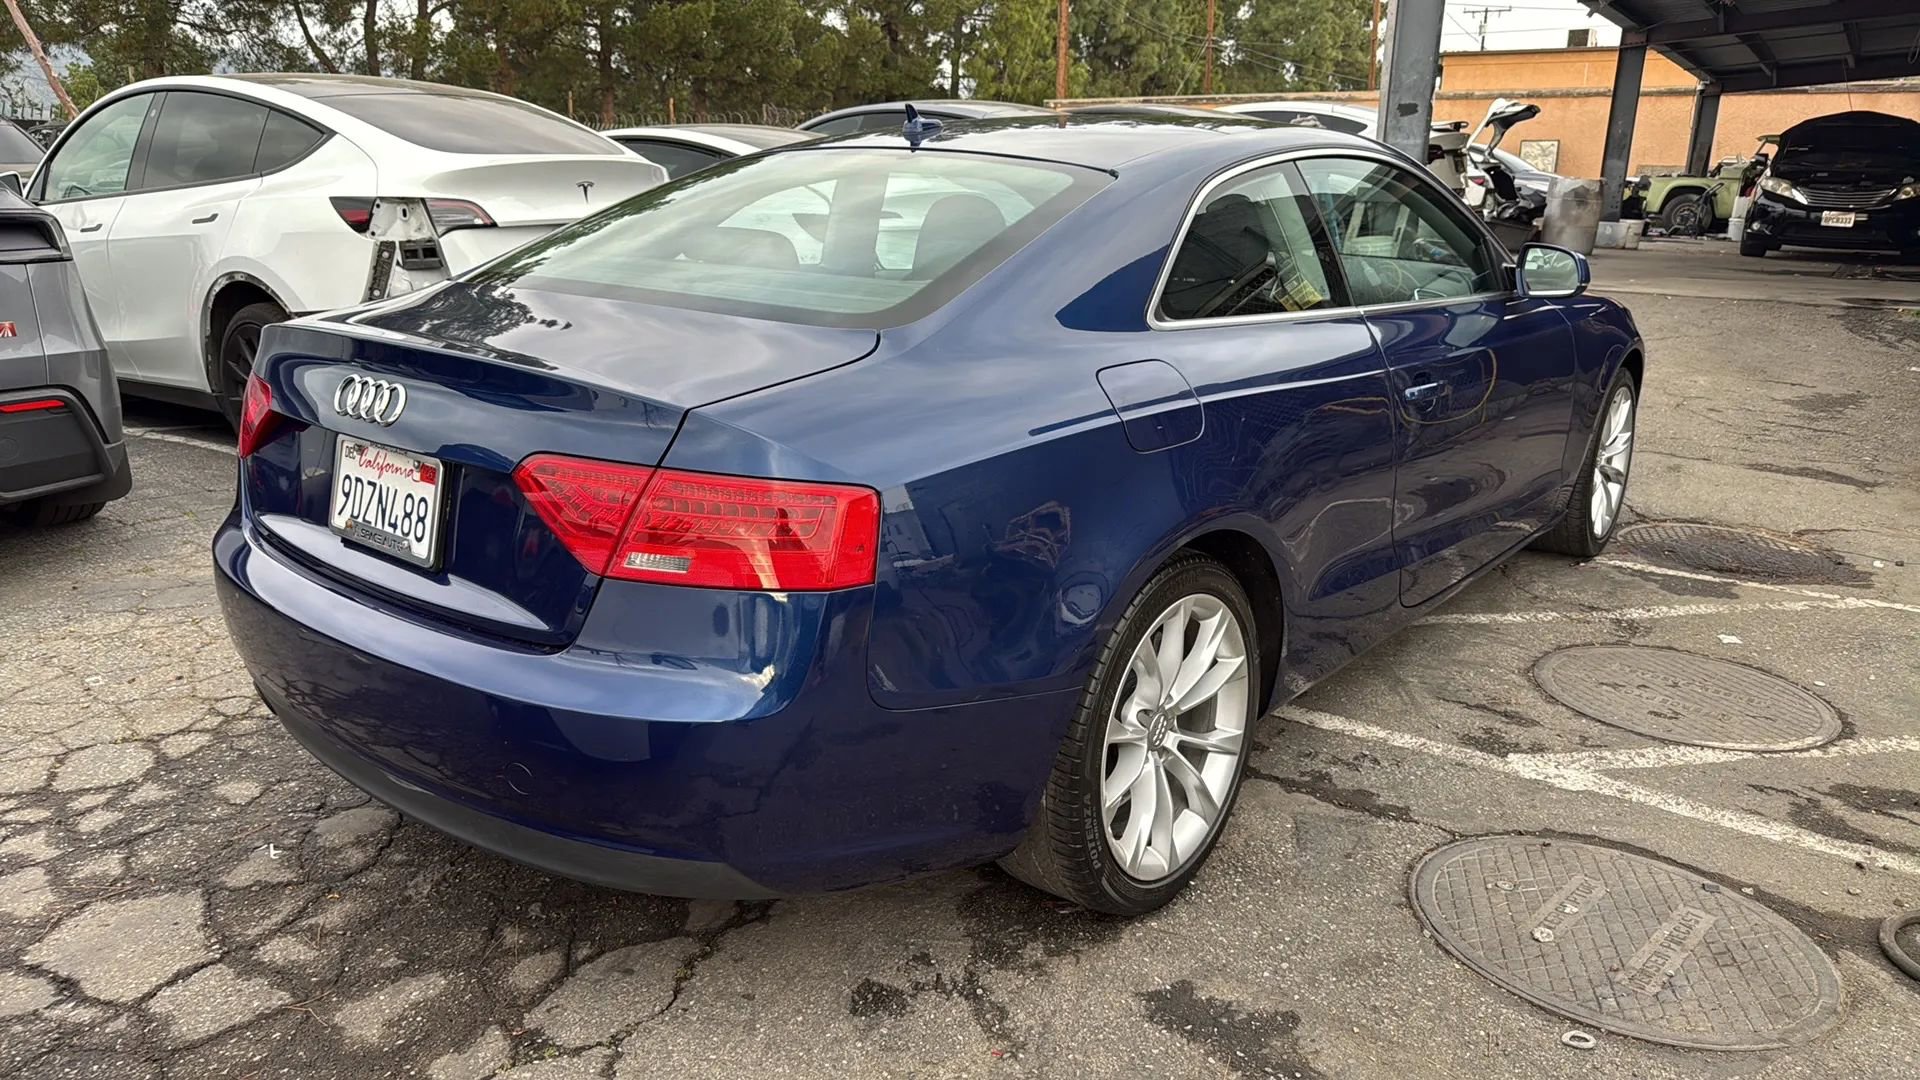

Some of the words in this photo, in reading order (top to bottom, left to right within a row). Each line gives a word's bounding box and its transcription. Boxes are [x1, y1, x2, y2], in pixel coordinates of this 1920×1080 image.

[358, 447, 420, 483] California
[337, 474, 429, 543] 9DZN488
[1082, 793, 1103, 870] POTENZA
[1660, 910, 1704, 953] PRECAST
